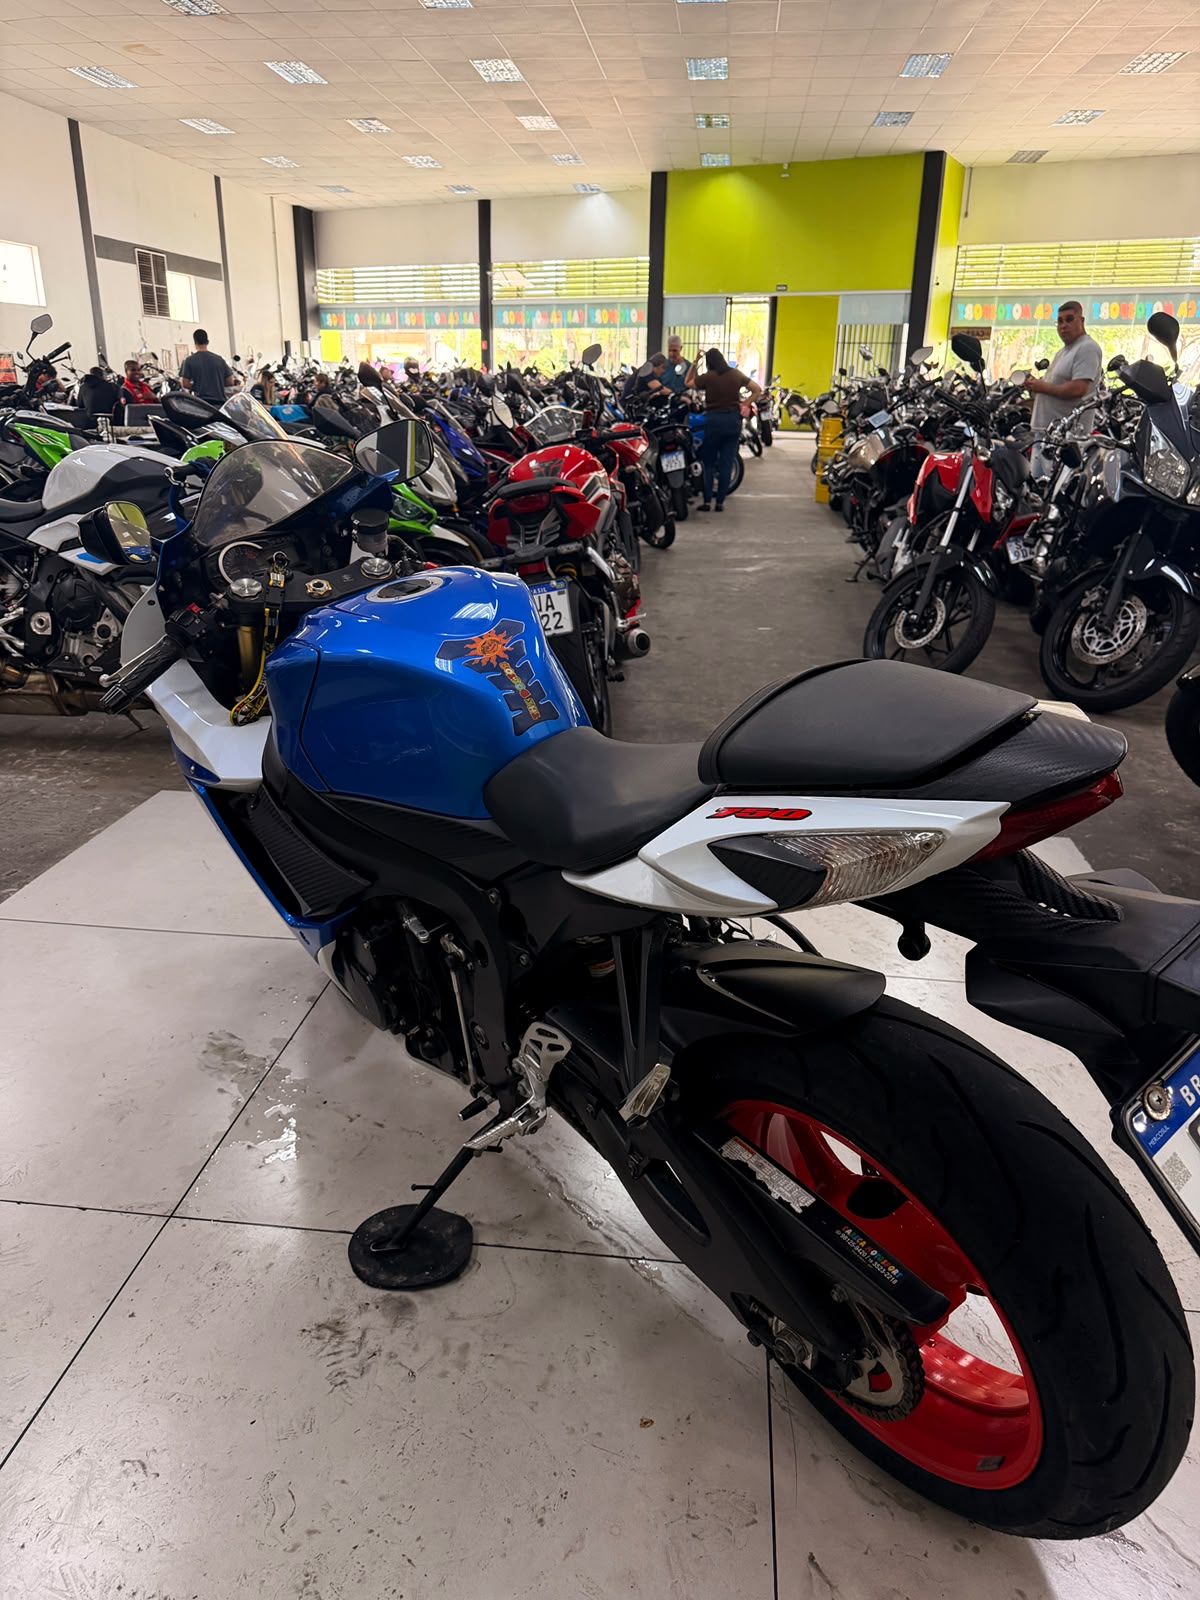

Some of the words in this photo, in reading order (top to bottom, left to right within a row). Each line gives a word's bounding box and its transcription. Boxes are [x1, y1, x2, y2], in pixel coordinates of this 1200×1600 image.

[541, 611, 564, 631] 22
[705, 807, 813, 821] 750
[1148, 1124, 1170, 1148] MERCOSUL
[842, 1226, 867, 1248] CARECA
[865, 1246, 903, 1279] MOTOSPORT
